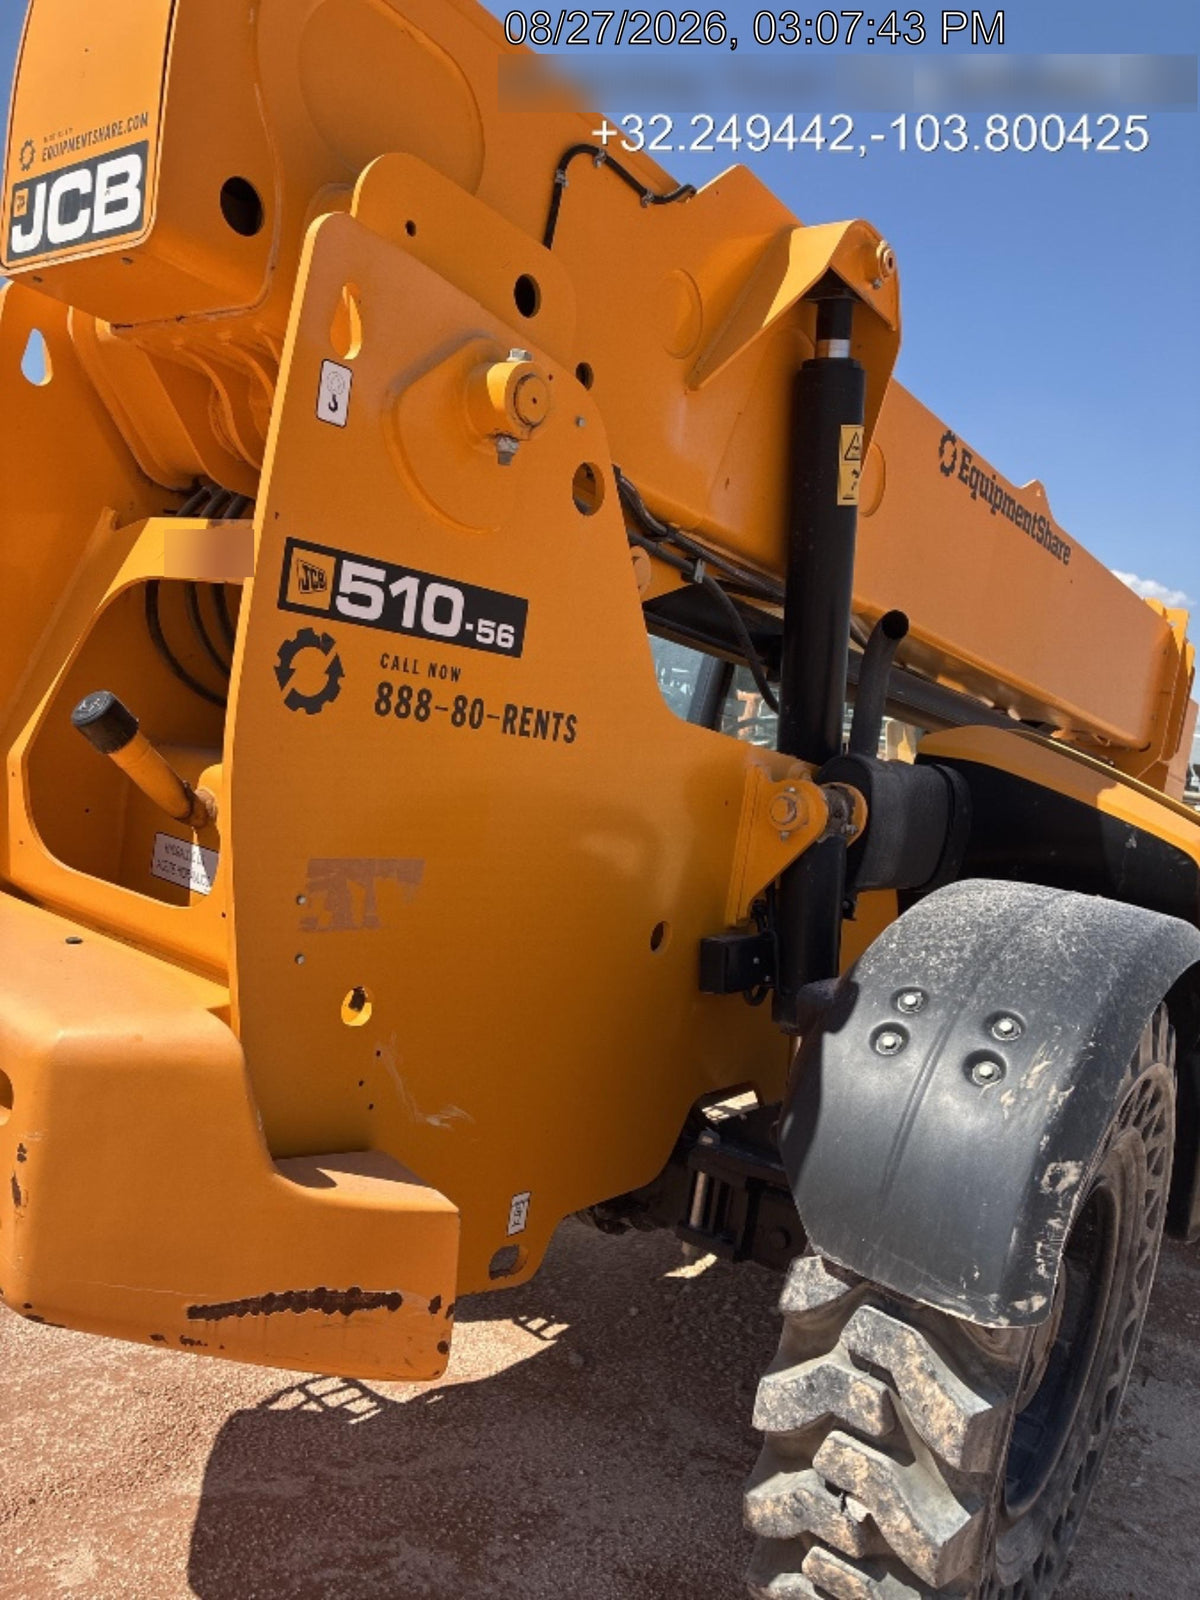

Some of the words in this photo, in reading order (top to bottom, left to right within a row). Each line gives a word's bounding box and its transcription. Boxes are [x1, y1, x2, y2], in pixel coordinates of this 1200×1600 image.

[41, 111, 149, 163] EQUIPMENTSHARE.COM
[11, 153, 142, 253] JCB
[958, 448, 1072, 566] EquipmentShare
[300, 562, 327, 593] JCB
[380, 652, 420, 675] CALL
[428, 661, 462, 683] NOW
[374, 681, 578, 744] 888-80-RENTS
